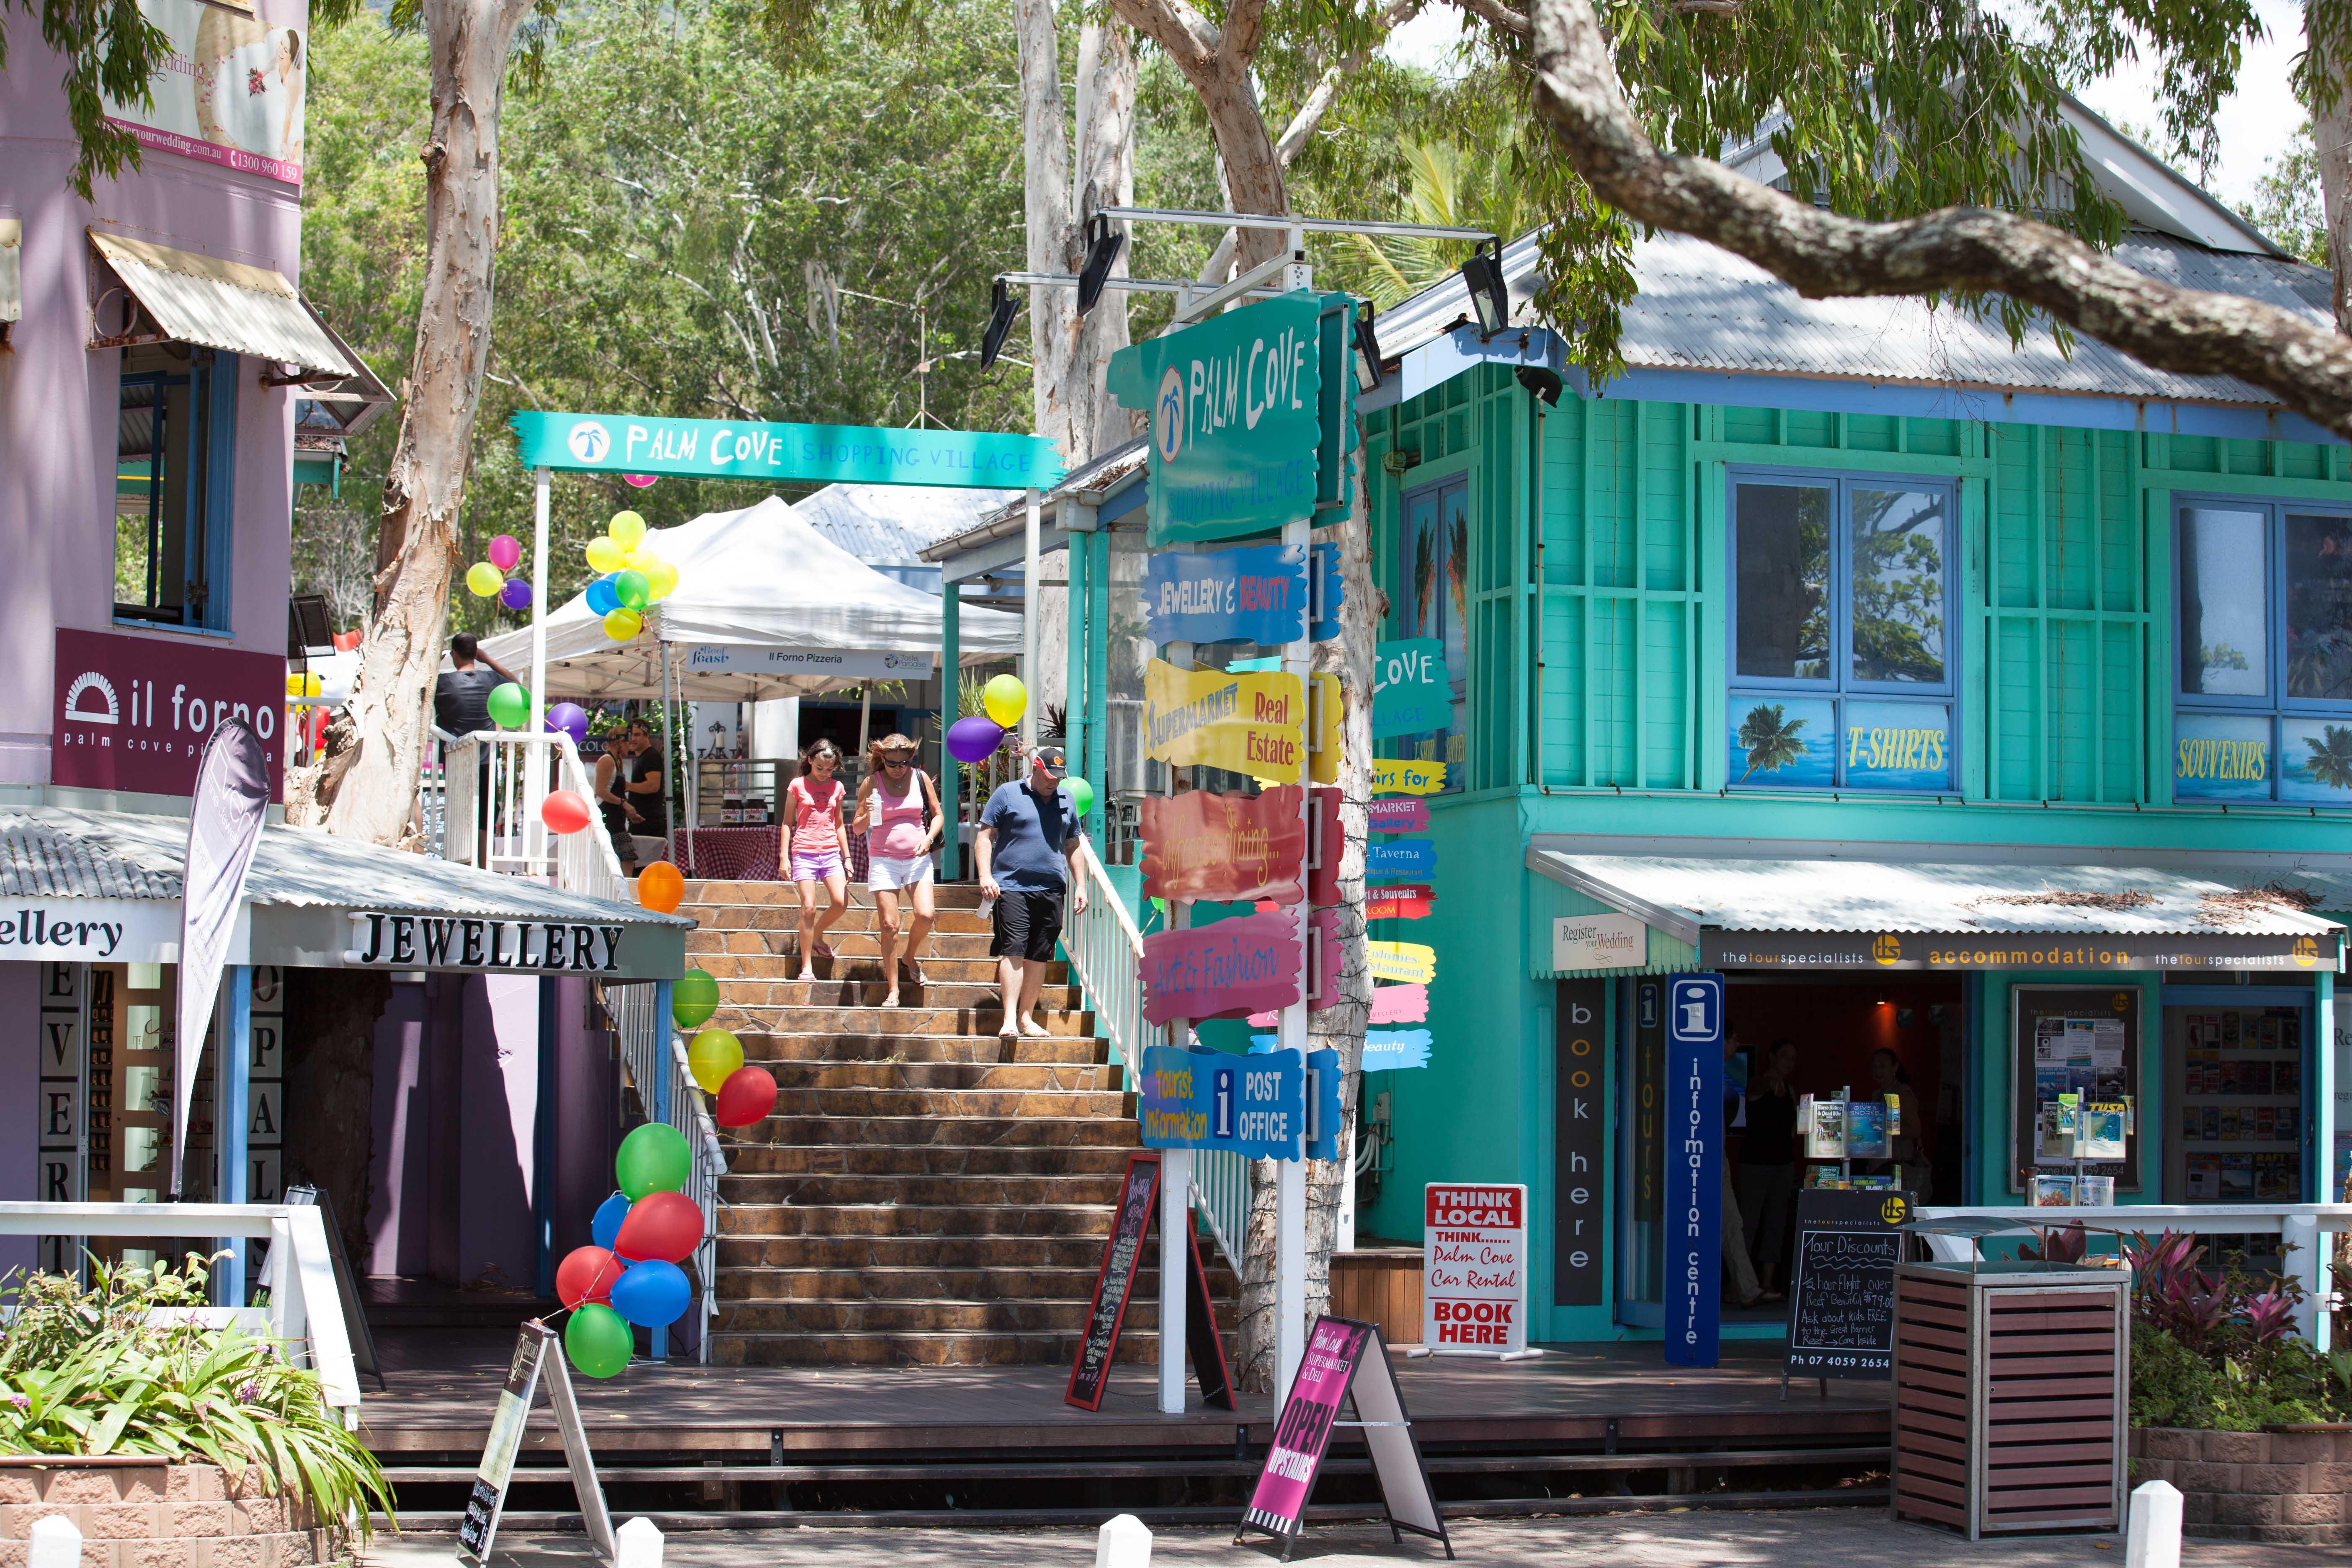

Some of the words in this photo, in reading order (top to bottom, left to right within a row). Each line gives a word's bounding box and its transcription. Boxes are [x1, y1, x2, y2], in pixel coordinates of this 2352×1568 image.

[237, 153, 259, 171] 1300
[262, 159, 278, 176] 960
[281, 162, 297, 181] 159
[1189, 345, 1240, 451] PALM
[1246, 327, 1305, 430] COVE
[627, 424, 698, 462] PALM
[711, 429, 783, 466] COVE
[802, 442, 920, 468] SHOPPING
[930, 449, 1031, 473] VILLAGE
[1167, 476, 1236, 526] SHOPPING
[1239, 459, 1305, 510] VILLAGE
[1156, 578, 1223, 616] JEWELLERY
[1226, 578, 1235, 614] &
[1239, 575, 1290, 611] BEAUTY
[692, 651, 726, 665] feast
[703, 646, 727, 655] Reef
[776, 652, 805, 663] Forno
[807, 654, 843, 664] Pizzeria
[132, 679, 152, 728] il
[171, 684, 275, 739] forno
[1148, 682, 1238, 751] SUPERMARKET
[1255, 692, 1289, 725] Real
[1372, 707, 1425, 727] LLAGE
[64, 732, 111, 747] palm
[127, 739, 172, 753] cove
[578, 741, 608, 752] COLO
[1247, 731, 1295, 766] Estate
[1848, 725, 1945, 771] T-SHIRTS
[2177, 737, 2267, 781] SOUVENIRS
[1376, 768, 1395, 787] irs
[1403, 769, 1431, 787] for
[1369, 802, 1416, 814] MARKET
[1368, 818, 1416, 829] Gallery
[1372, 846, 1420, 859] Taverna
[1372, 890, 1379, 900] &
[1380, 888, 1417, 899] Souvenirs
[361, 913, 624, 972] JEWELLERY
[1562, 924, 1597, 942] Register
[1586, 939, 1598, 950] your
[1598, 932, 1634, 951] Wedding
[1722, 951, 1864, 965] thetourspecialists
[1929, 947, 2129, 965] accommodation
[2155, 954, 2285, 967] thetourspecialists
[1153, 951, 1181, 1002] Art
[1184, 950, 1199, 990] &
[1203, 938, 1280, 996] Fashion
[1371, 962, 1425, 978] staurant
[1371, 1009, 1402, 1018] WELLERY
[1571, 1003, 1591, 1119] book
[1155, 1065, 1194, 1101] Tourist
[1246, 1071, 1282, 1101] POST
[2090, 1104, 2126, 1112] TUSA
[1145, 1106, 1208, 1141] Information
[1239, 1111, 1288, 1142] OFFICE
[1642, 1045, 1653, 1200] tours
[1685, 1057, 1703, 1238] information
[2036, 1166, 2060, 1175] hone
[2062, 1166, 2073, 1175] 07
[2083, 1166, 2099, 1174] 59
[2101, 1166, 2124, 1175] 2654
[1435, 1191, 1513, 1208] THINK
[1570, 1151, 1589, 1268] here
[1435, 1210, 1514, 1226] LOCAL
[1805, 1233, 1834, 1253] Tour
[1838, 1235, 1896, 1256] Discounts
[1433, 1245, 1475, 1265] Palm
[1480, 1246, 1514, 1265] Cove
[1431, 1269, 1462, 1287] Car
[1467, 1269, 1516, 1289] Rental
[1818, 1272, 1837, 1290] hour
[1867, 1279, 1891, 1290] over
[1685, 1250, 1699, 1344] centre
[1806, 1291, 1828, 1308] Reef
[1831, 1292, 1862, 1307] Beautiful
[1434, 1302, 1513, 1323] BOOK
[1801, 1309, 1818, 1324] Ask
[1822, 1310, 1845, 1323] about
[1849, 1310, 1865, 1322] kids
[1867, 1309, 1887, 1322] FREE
[1438, 1323, 1508, 1345] HERE
[1801, 1325, 1812, 1335] to
[1813, 1324, 1828, 1335] the
[1830, 1324, 1847, 1334] Great
[1850, 1323, 1876, 1334] Barrier
[1313, 1327, 1327, 1351] Palm
[1327, 1330, 1342, 1354] Cove
[1803, 1335, 1825, 1346] Reef
[1838, 1336, 1854, 1345] Come
[1857, 1334, 1877, 1346] Inside
[1307, 1351, 1349, 1373] SUPERMARKET
[1791, 1354, 1804, 1364] Ph
[1809, 1355, 1823, 1365] 07
[1827, 1357, 1857, 1367] 4059
[1861, 1358, 1890, 1368] 2654
[1301, 1367, 1308, 1380] &
[1308, 1367, 1324, 1383] DELI
[1279, 1397, 1335, 1456] OPEN
[1267, 1446, 1315, 1484] UPSTAIRS
[477, 1521, 489, 1550] $5
